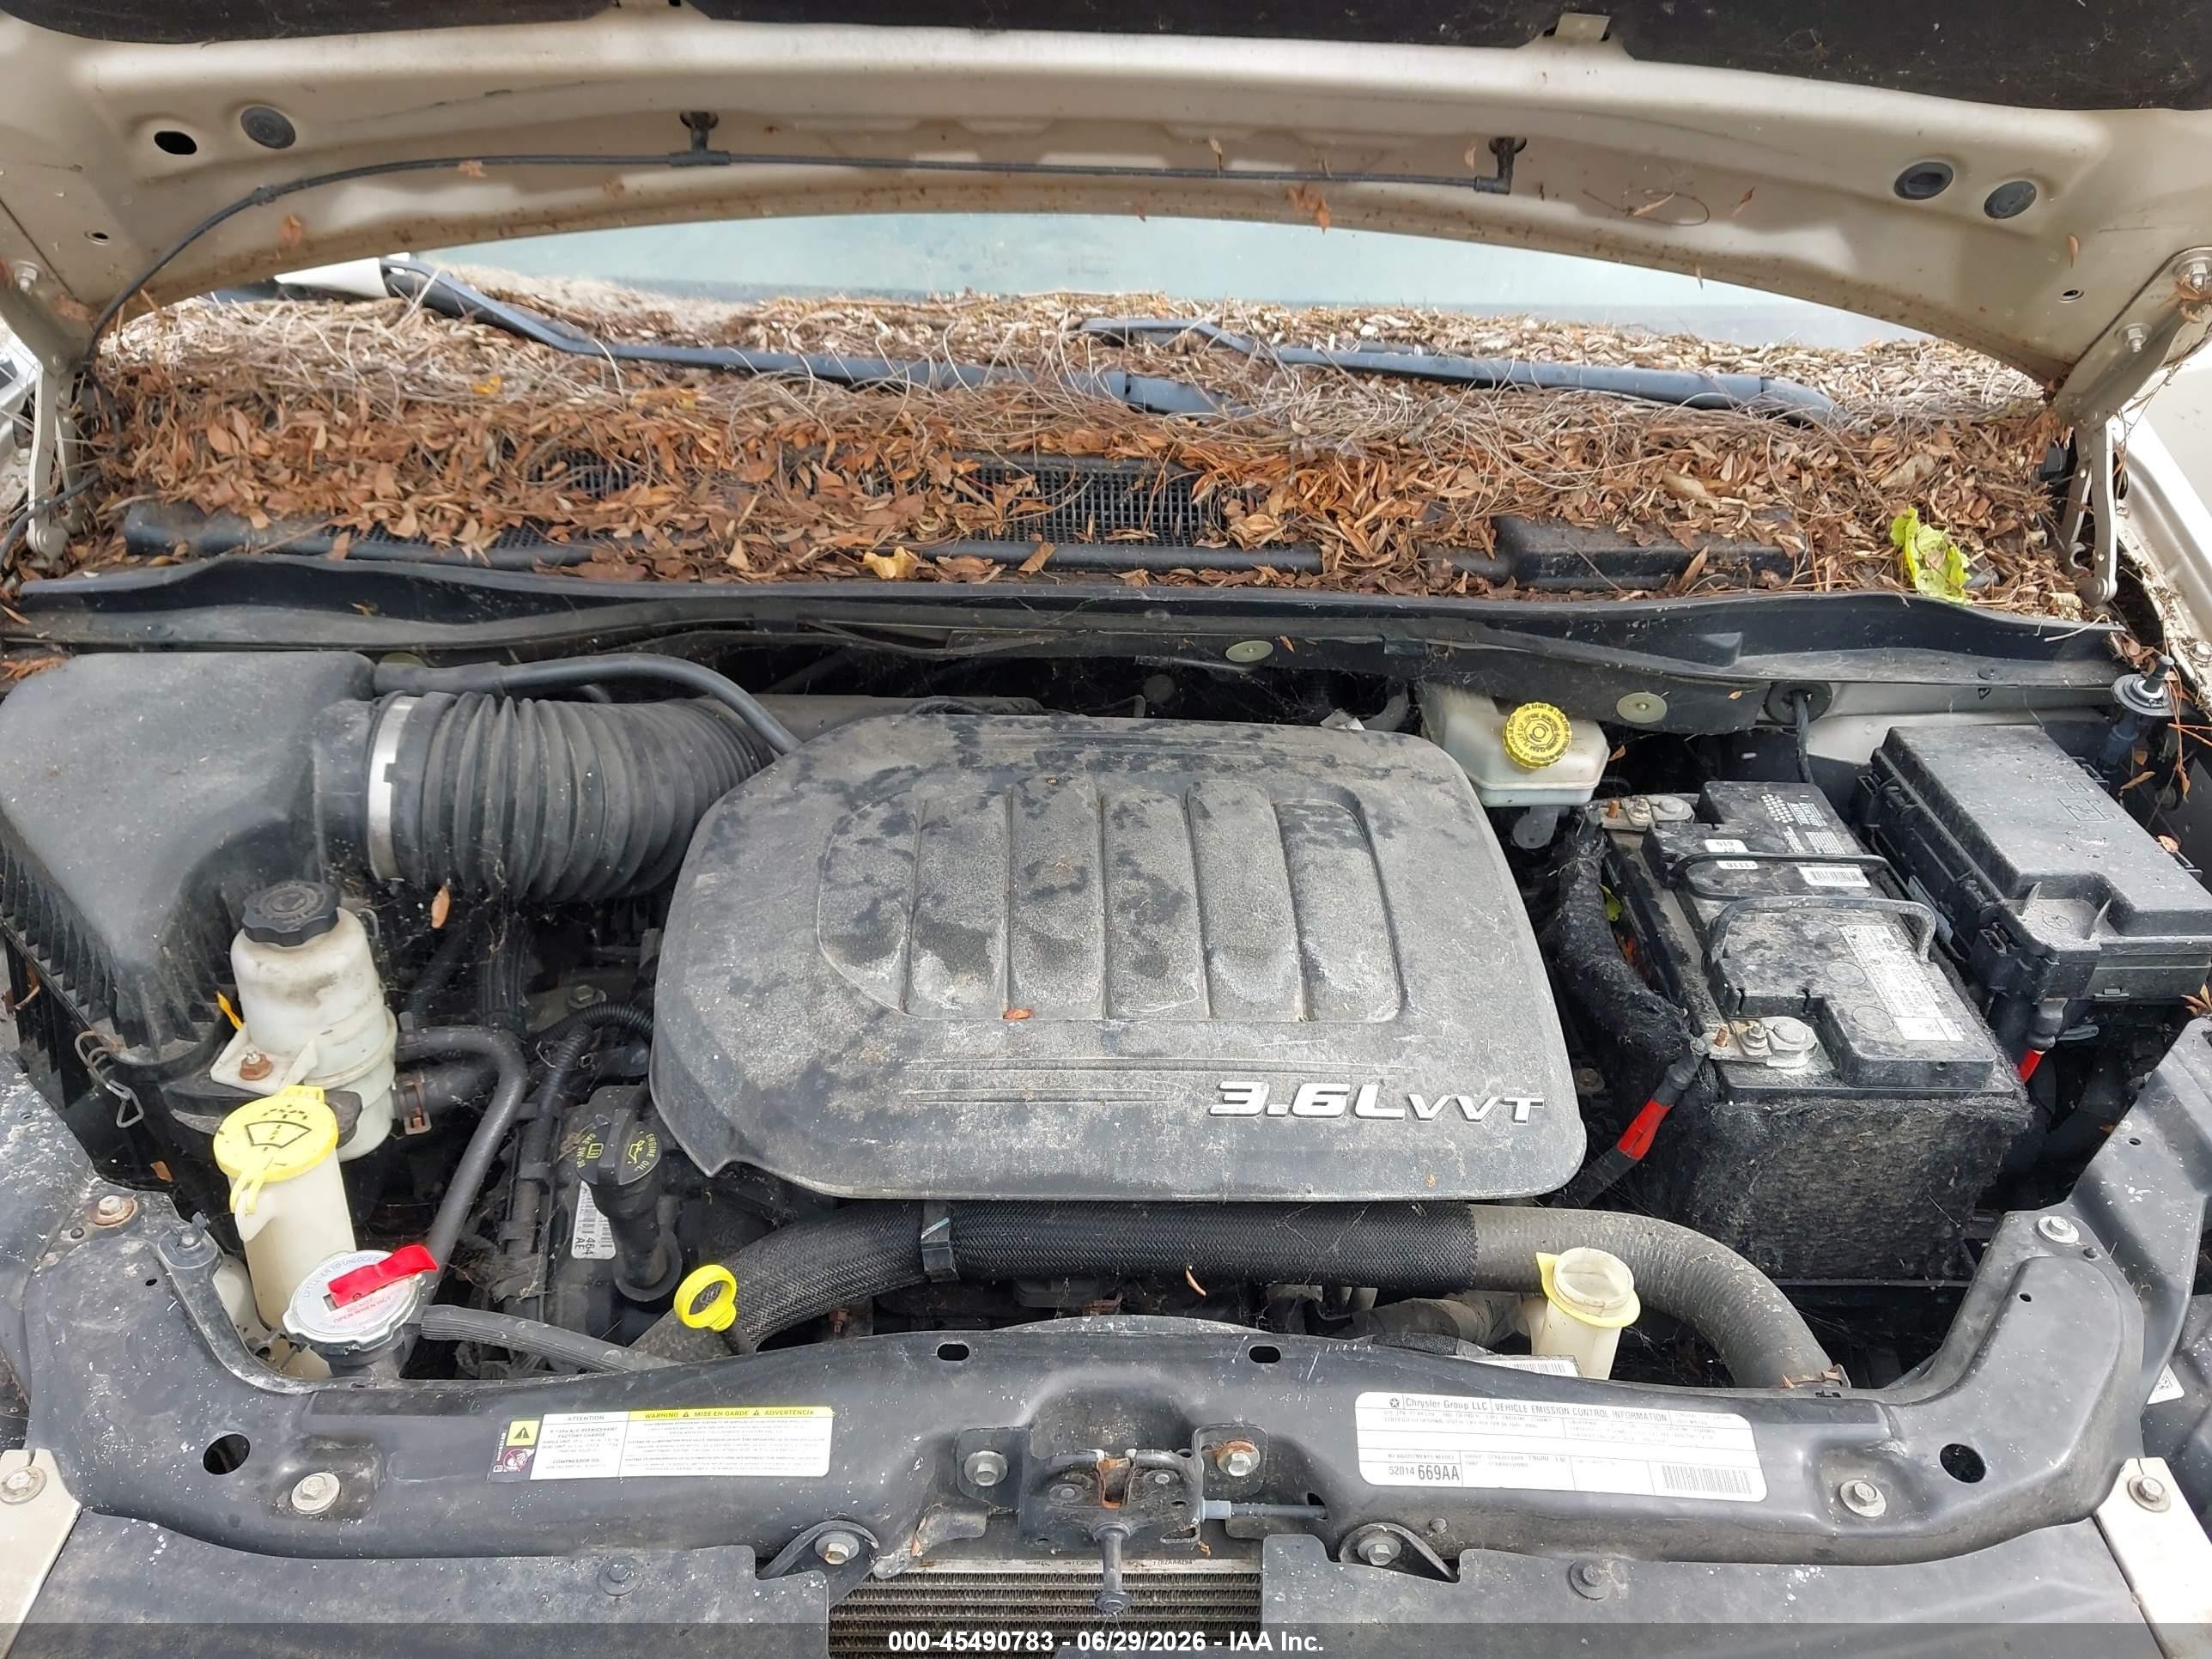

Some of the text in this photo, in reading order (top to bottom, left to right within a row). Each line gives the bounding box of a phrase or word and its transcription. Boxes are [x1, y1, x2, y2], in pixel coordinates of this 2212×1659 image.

[1209, 1081, 1545, 1124] 3.6L VVT
[645, 1133, 655, 1158] ENGINE
[574, 1237, 585, 1251] AE
[586, 1237, 595, 1256] 464
[1406, 1397, 1487, 1411] Chrysler Group LLC
[1495, 1403, 1528, 1414] VEHICLE
[1531, 1405, 1570, 1416] EMISSION
[1572, 1407, 1608, 1419] CONTROL
[1612, 1410, 1668, 1422] INFORMATION
[1389, 1464, 1460, 1480] 52014 669AA
